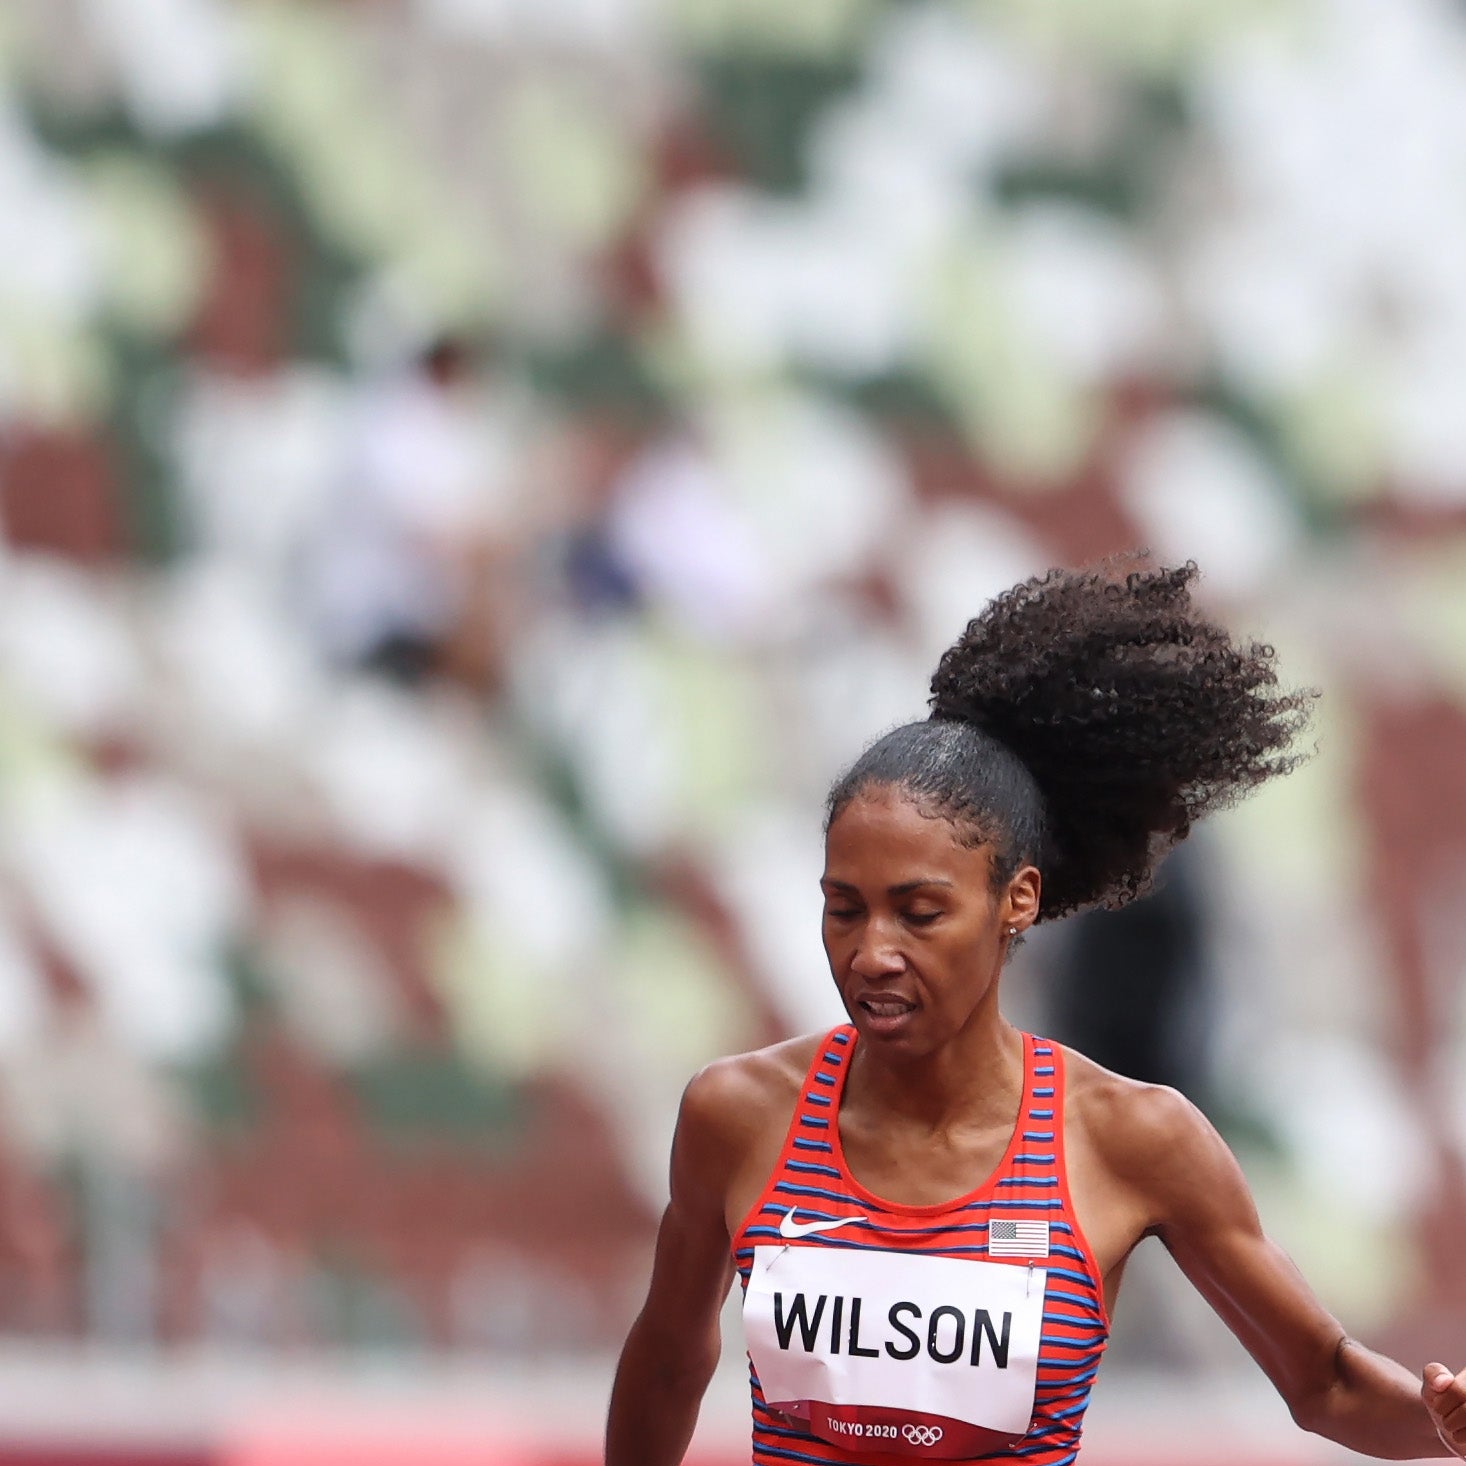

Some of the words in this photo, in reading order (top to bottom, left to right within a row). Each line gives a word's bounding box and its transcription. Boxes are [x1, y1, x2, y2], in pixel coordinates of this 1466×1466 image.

[774, 1292, 1012, 1369] WILSON
[827, 1417, 863, 1437] TOKYO
[865, 1424, 898, 1438] 2020
